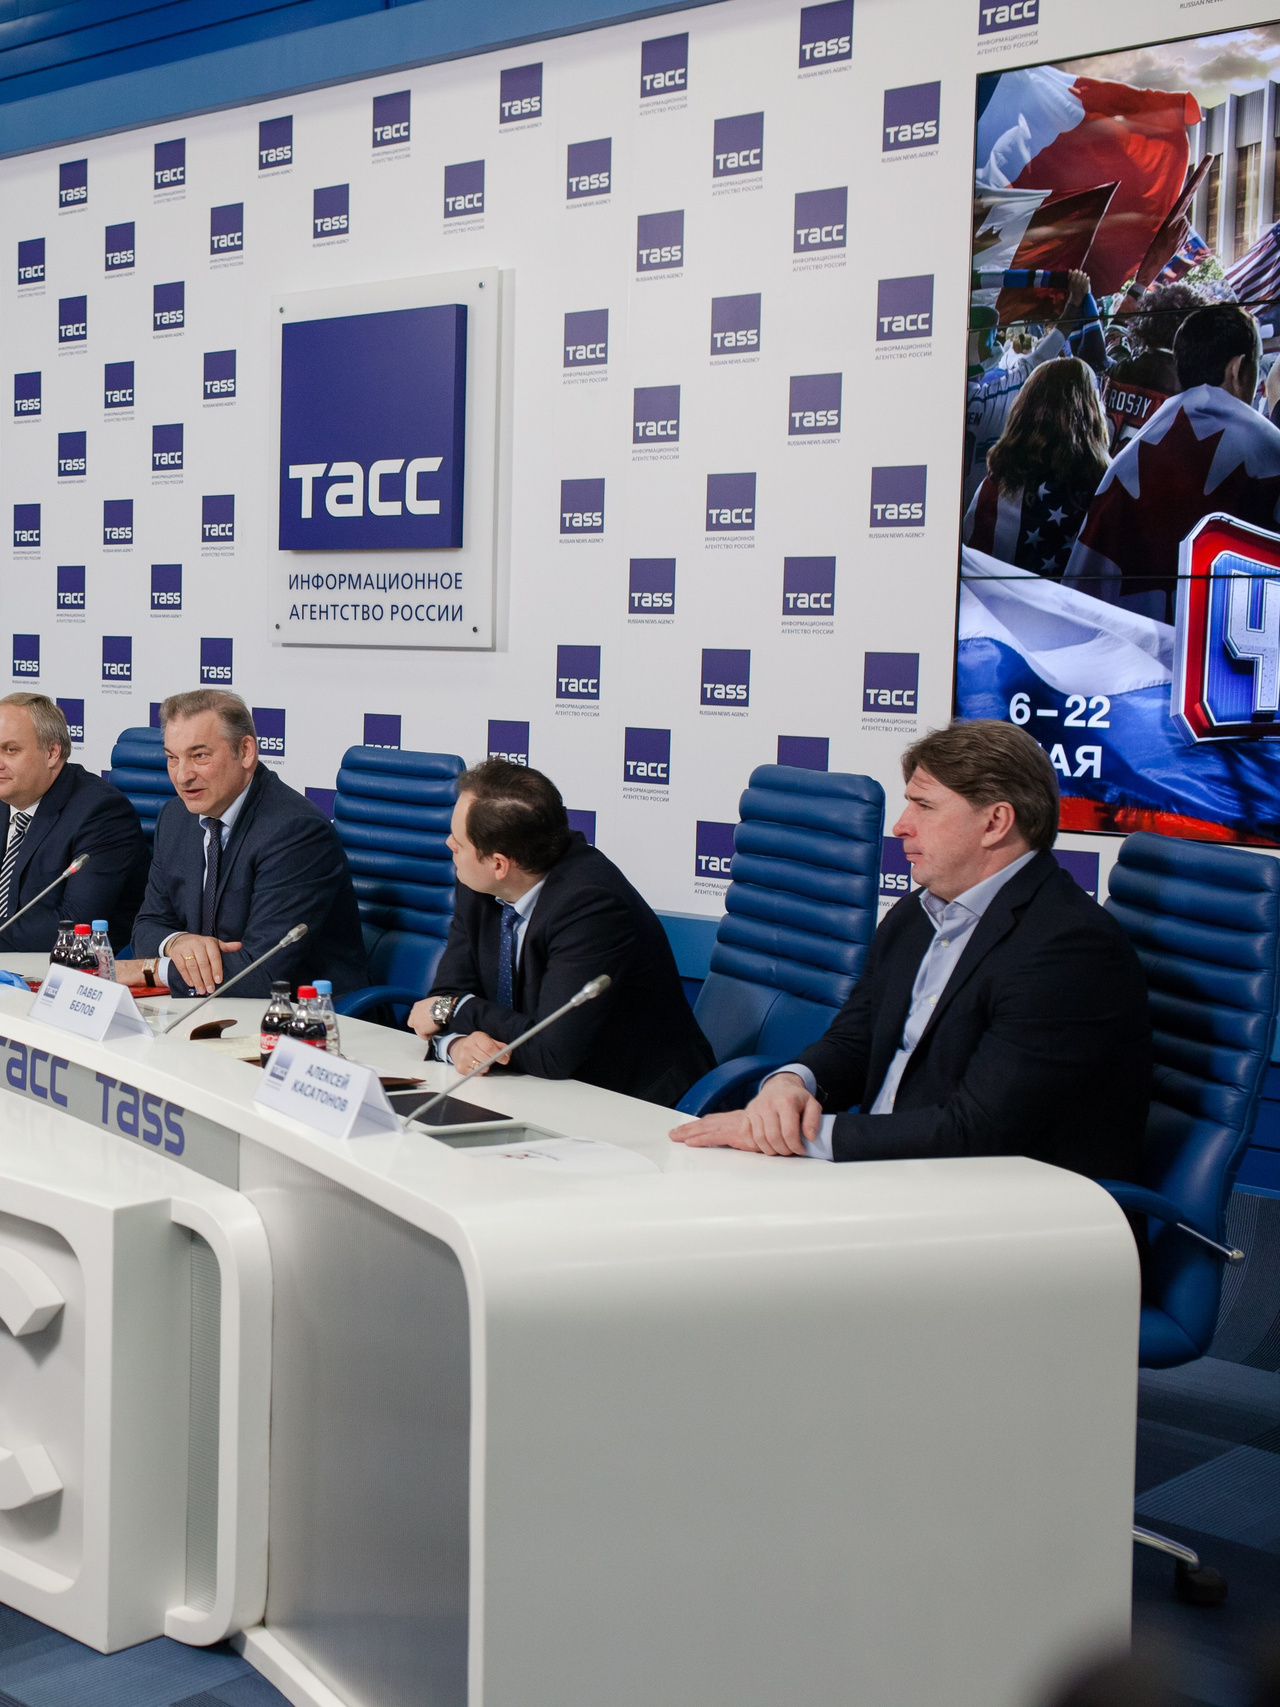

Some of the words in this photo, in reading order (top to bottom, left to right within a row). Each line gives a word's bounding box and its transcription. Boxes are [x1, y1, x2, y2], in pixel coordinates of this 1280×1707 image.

[288, 572, 463, 593] ИНФОРМАЦИОННОЕ
[289, 604, 384, 620] АГЕНТСТВО
[390, 604, 463, 621] РОССИИ
[1038, 743, 1103, 778] АЯ
[76, 985, 103, 1002] ПАВЕЛ
[69, 1000, 96, 1016] БЕЛОВ
[306, 1064, 351, 1090] АЛЕКСЕЙ
[292, 1080, 349, 1112] КАСАТОНОВ
